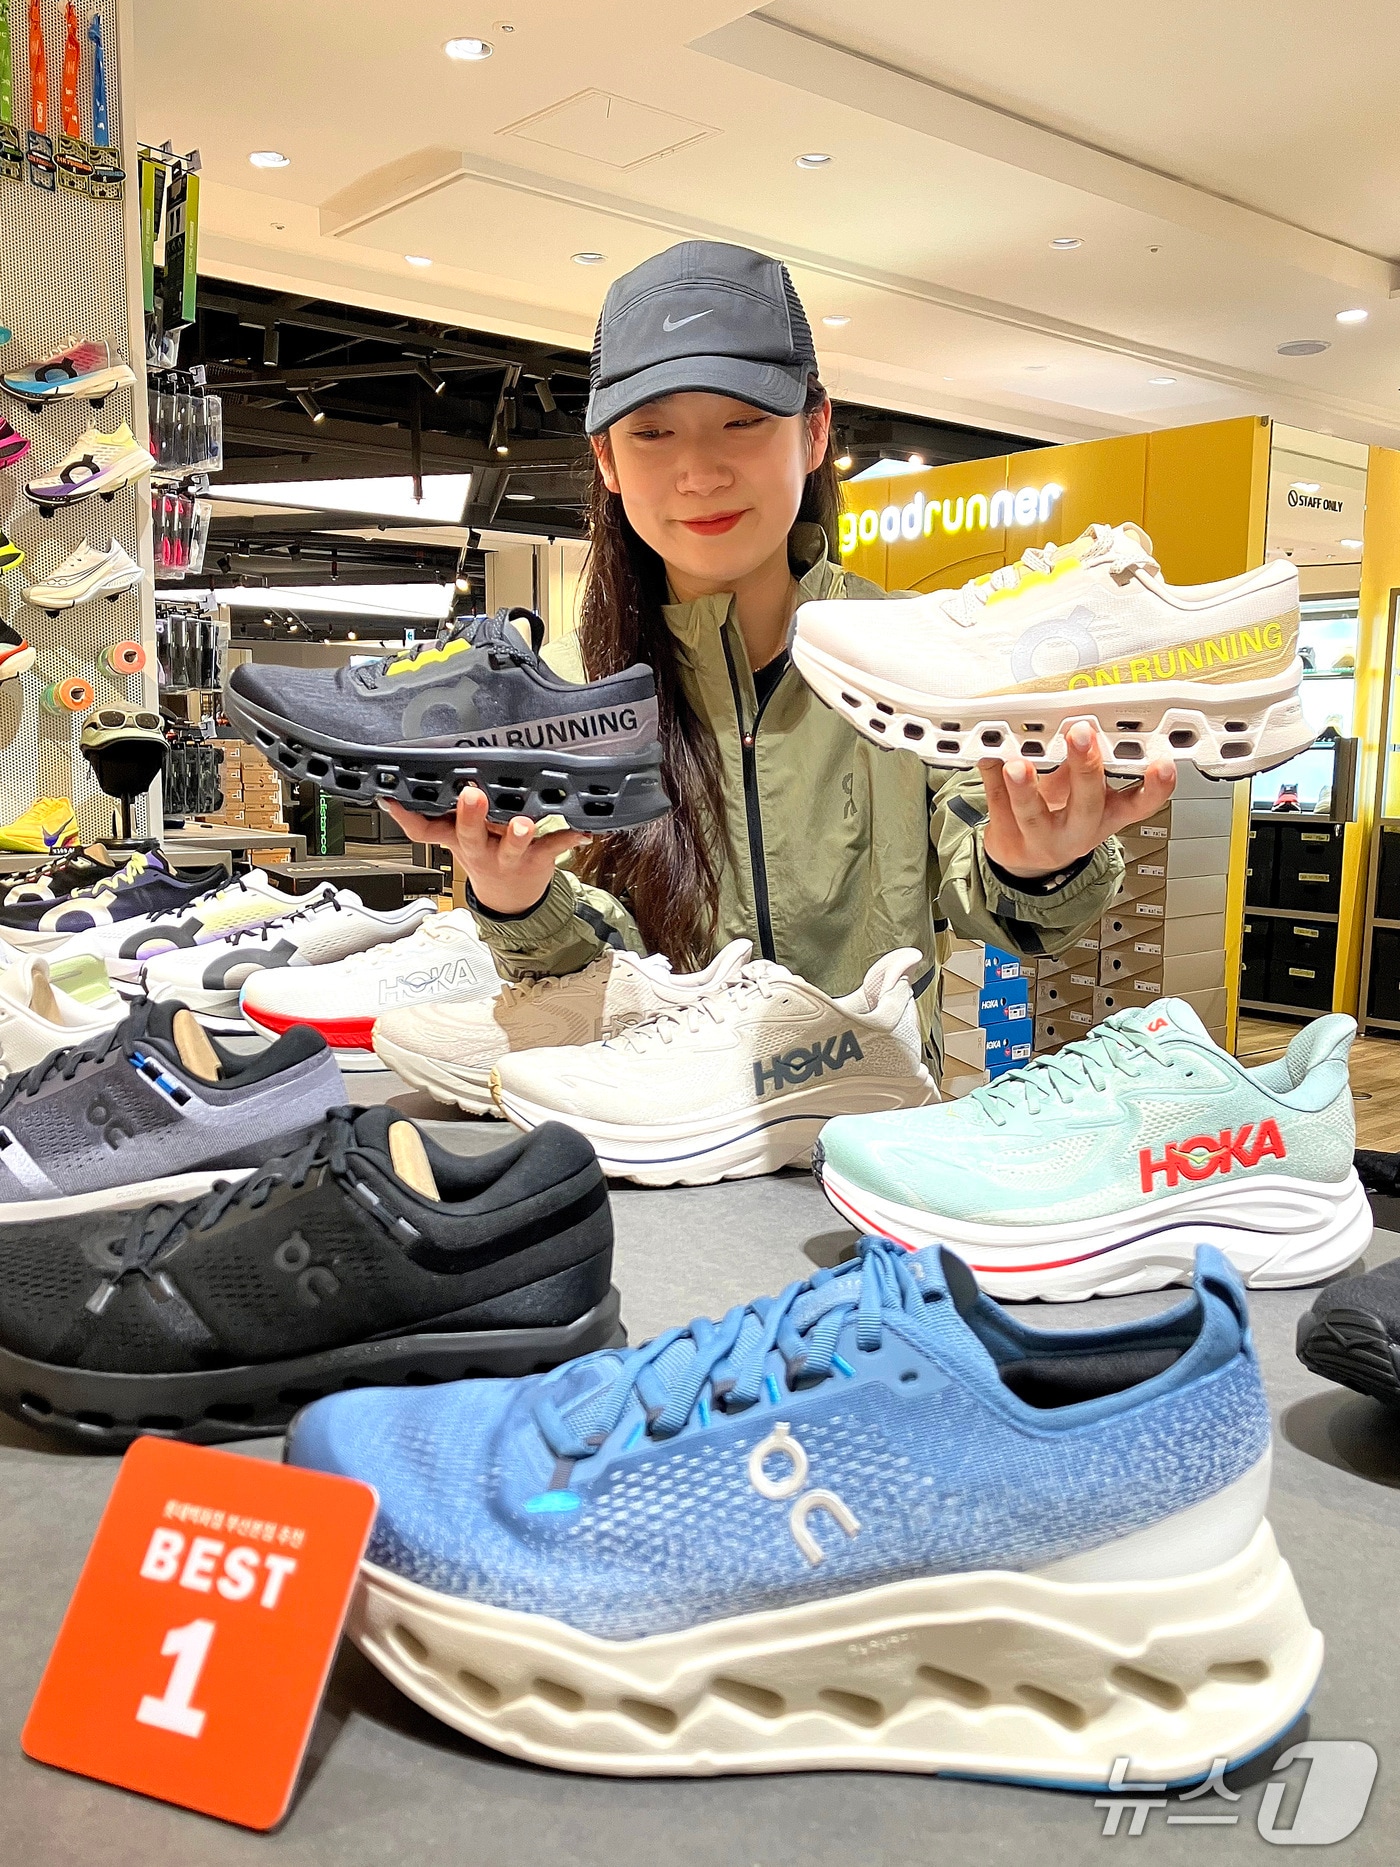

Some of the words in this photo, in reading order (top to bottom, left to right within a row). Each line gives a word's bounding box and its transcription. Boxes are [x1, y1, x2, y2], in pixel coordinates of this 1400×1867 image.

[839, 482, 1063, 556] goodrunner
[1298, 494, 1323, 510] STAFF
[1323, 499, 1344, 513] ONLY
[1130, 622, 1283, 683] RUNNING
[506, 708, 638, 749] RUNNING
[379, 958, 478, 1005] HOKA
[981, 999, 999, 1010] HOKA
[752, 1029, 866, 1096] HOKA
[1139, 1116, 1287, 1194] HOKA
[140, 1528, 298, 1610] BEST
[135, 1617, 215, 1739] 1
